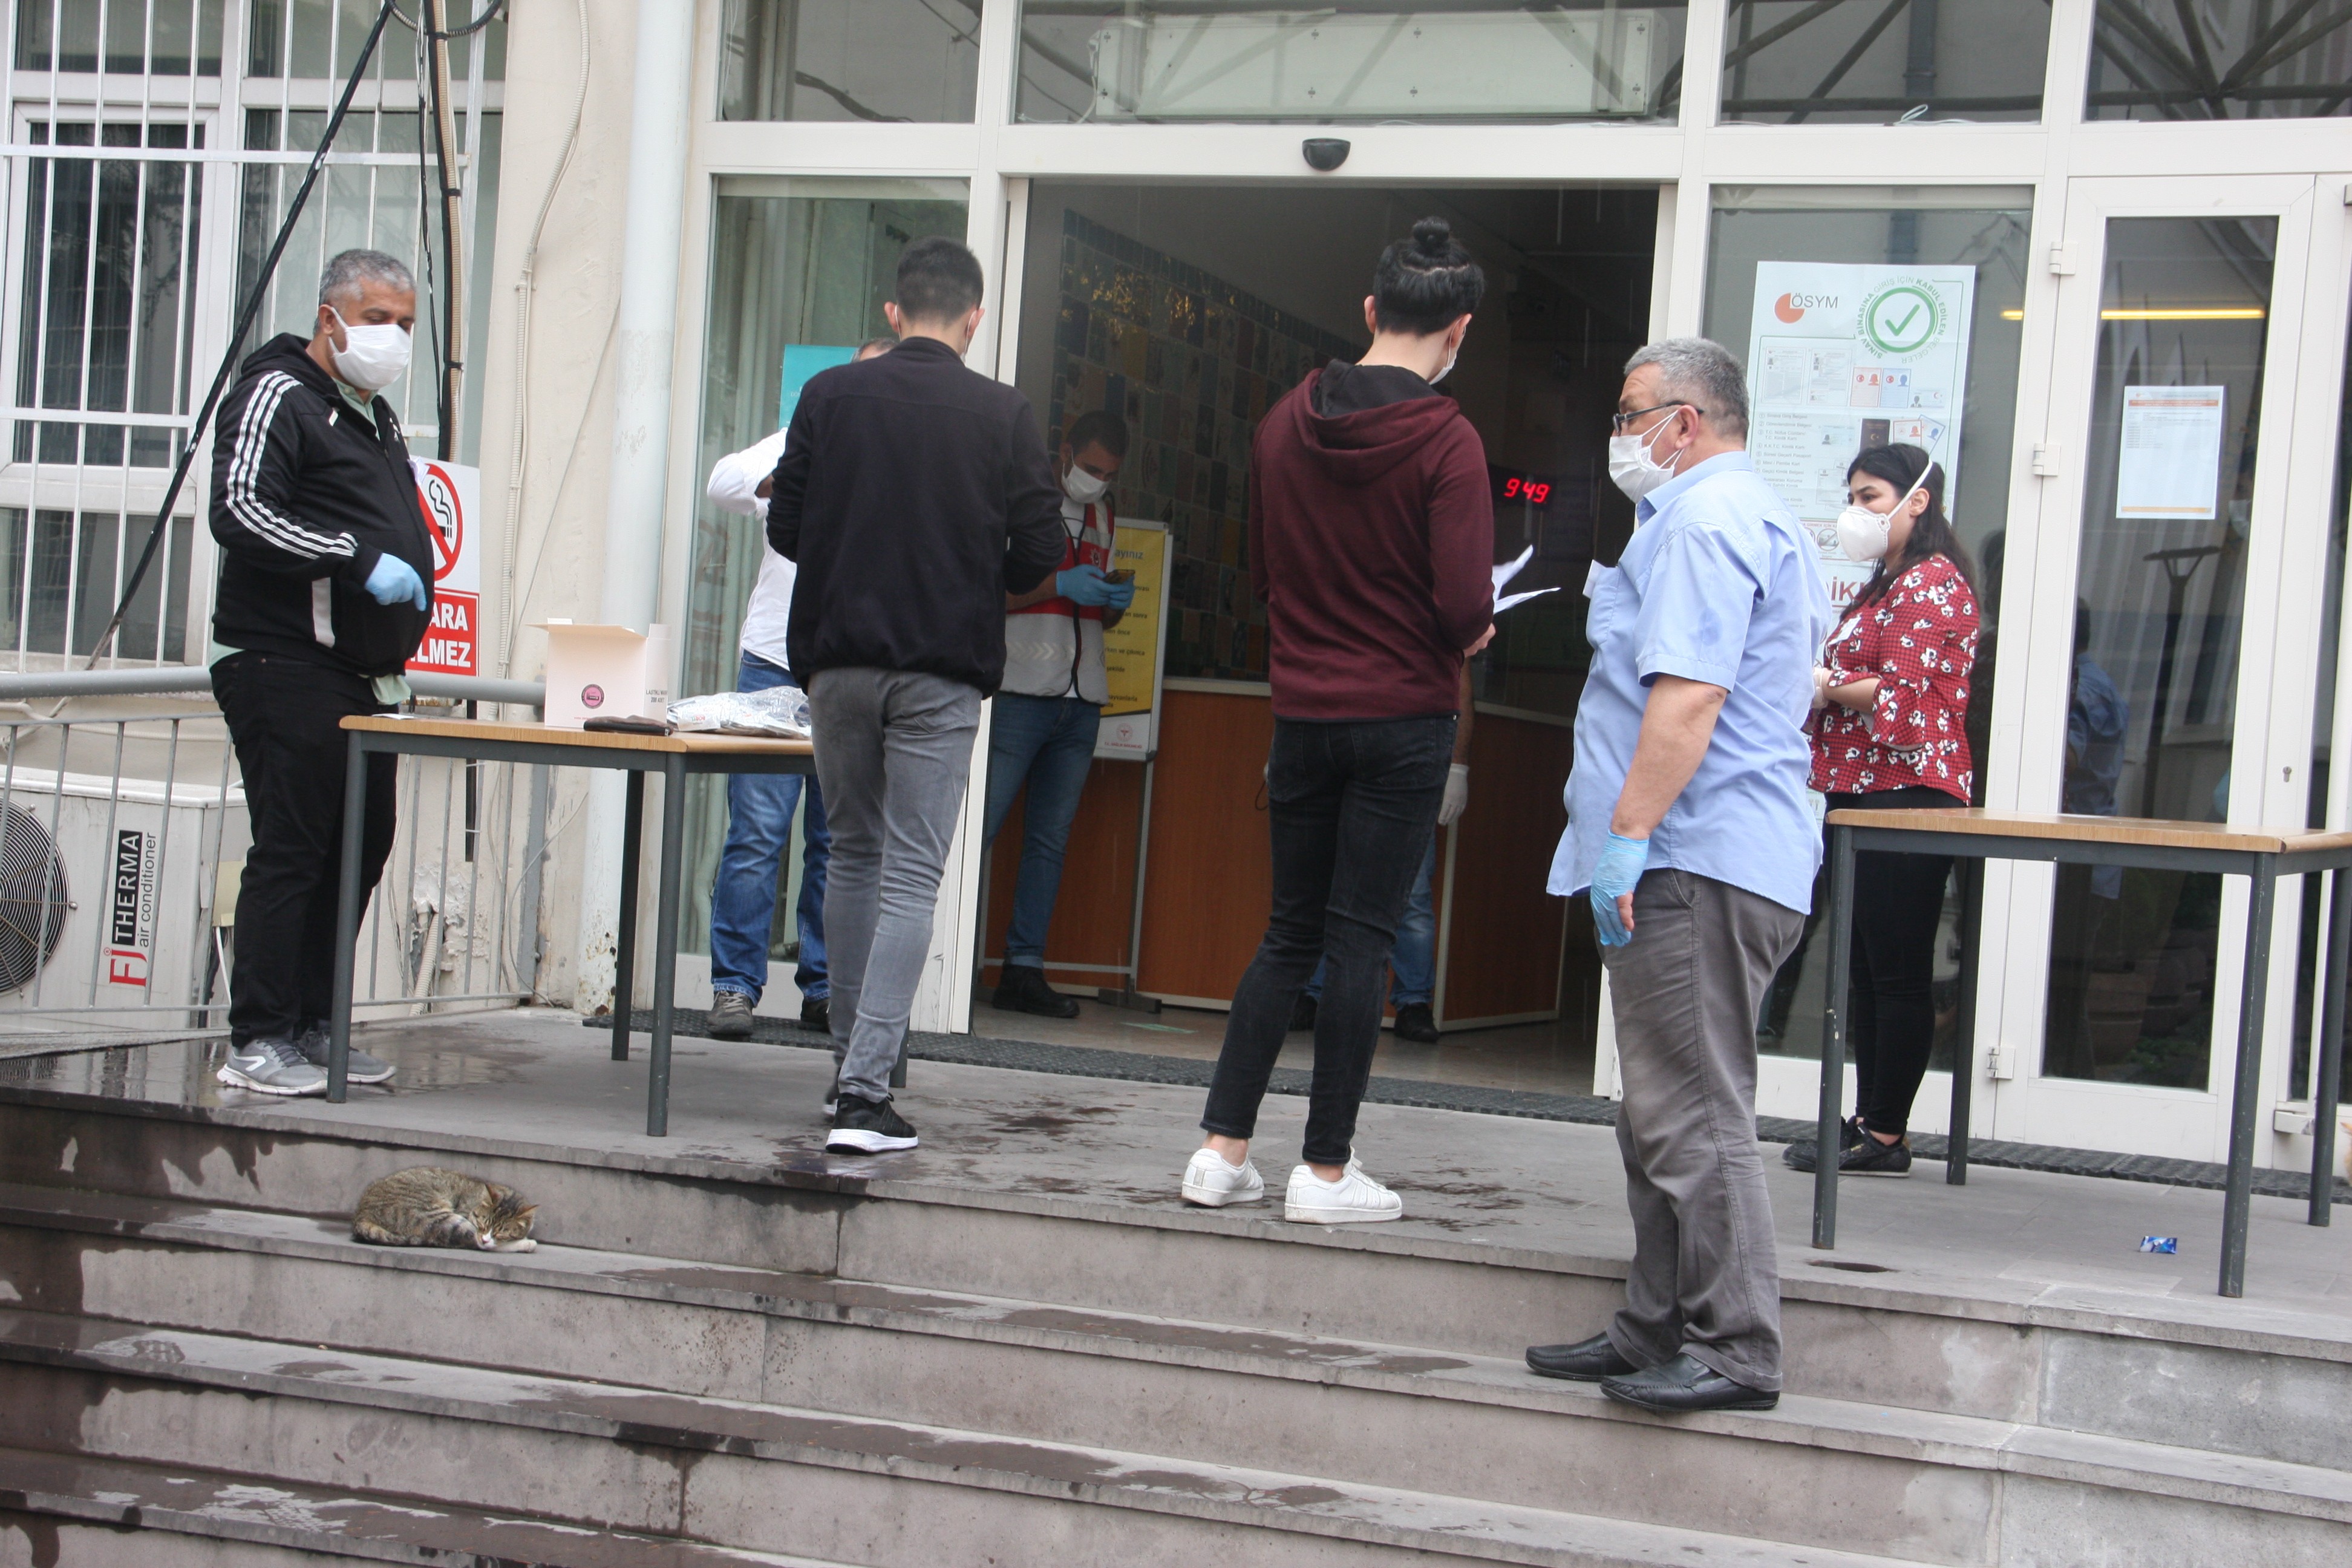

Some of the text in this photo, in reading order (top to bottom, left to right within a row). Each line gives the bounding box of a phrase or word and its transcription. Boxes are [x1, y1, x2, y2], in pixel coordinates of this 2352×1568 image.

[1896, 275, 1914, 284] İÇİN
[1916, 278, 1941, 301] KABUL
[1792, 293, 1838, 309] ÖSYM
[1938, 302, 1948, 336] EDİLEN
[1861, 338, 1883, 359] SINAV
[1901, 338, 1940, 364] BELGELER
[429, 601, 468, 631] ARA
[411, 638, 471, 668] LMEZ
[115, 834, 140, 942] THERMA
[137, 832, 157, 948] air conditioner
